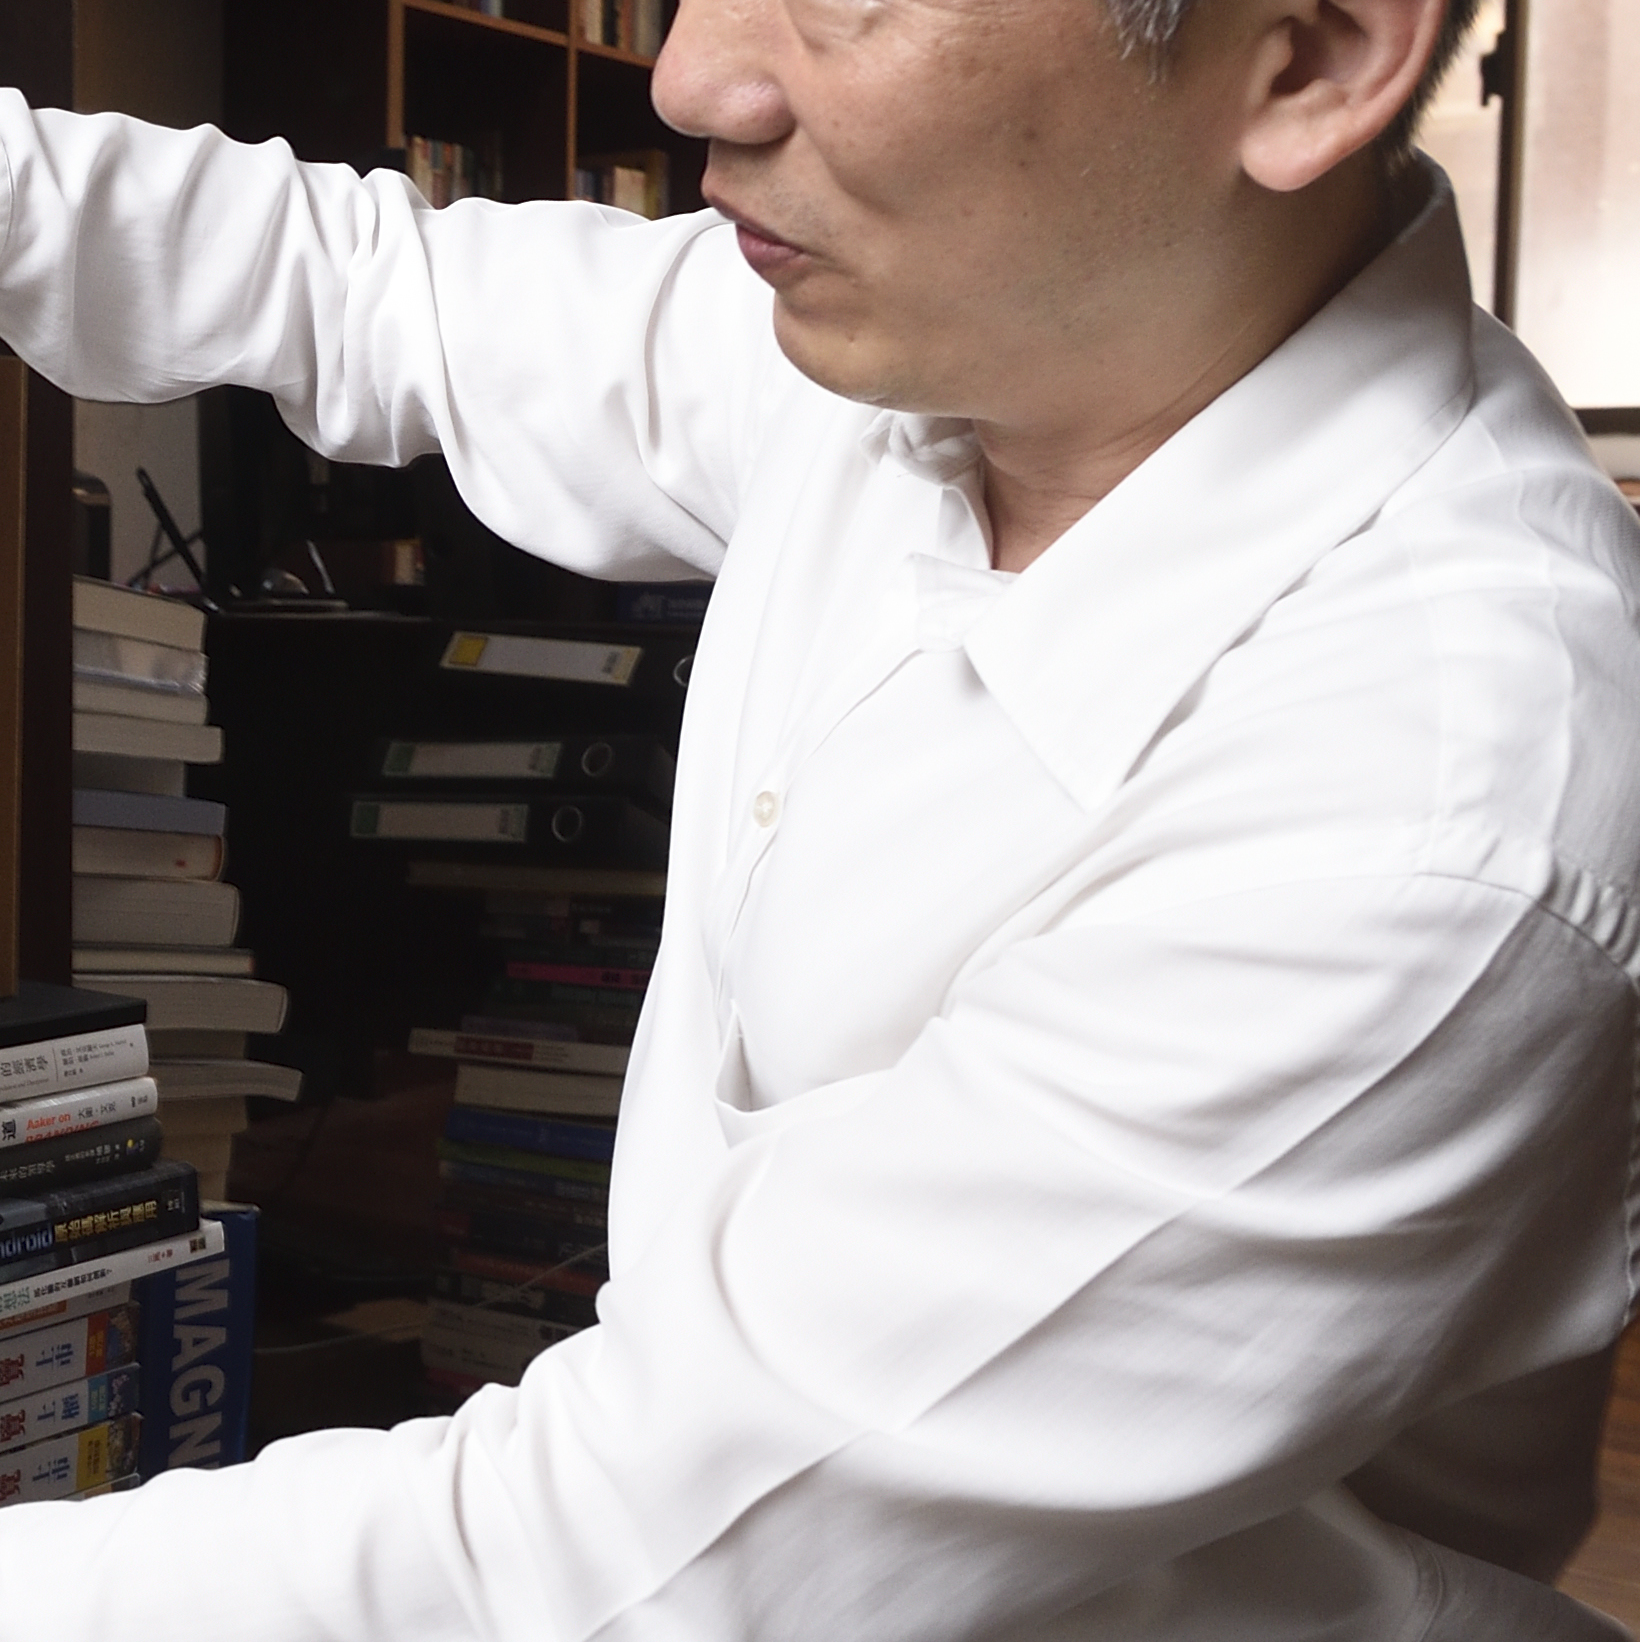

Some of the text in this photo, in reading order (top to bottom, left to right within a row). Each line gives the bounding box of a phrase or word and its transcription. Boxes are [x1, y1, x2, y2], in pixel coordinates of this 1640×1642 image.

[26, 1113, 71, 1130] Aaker on
[35, 1343, 74, 1368] 上市
[167, 1258, 230, 1468] MAGN
[32, 1457, 71, 1483] 上市
